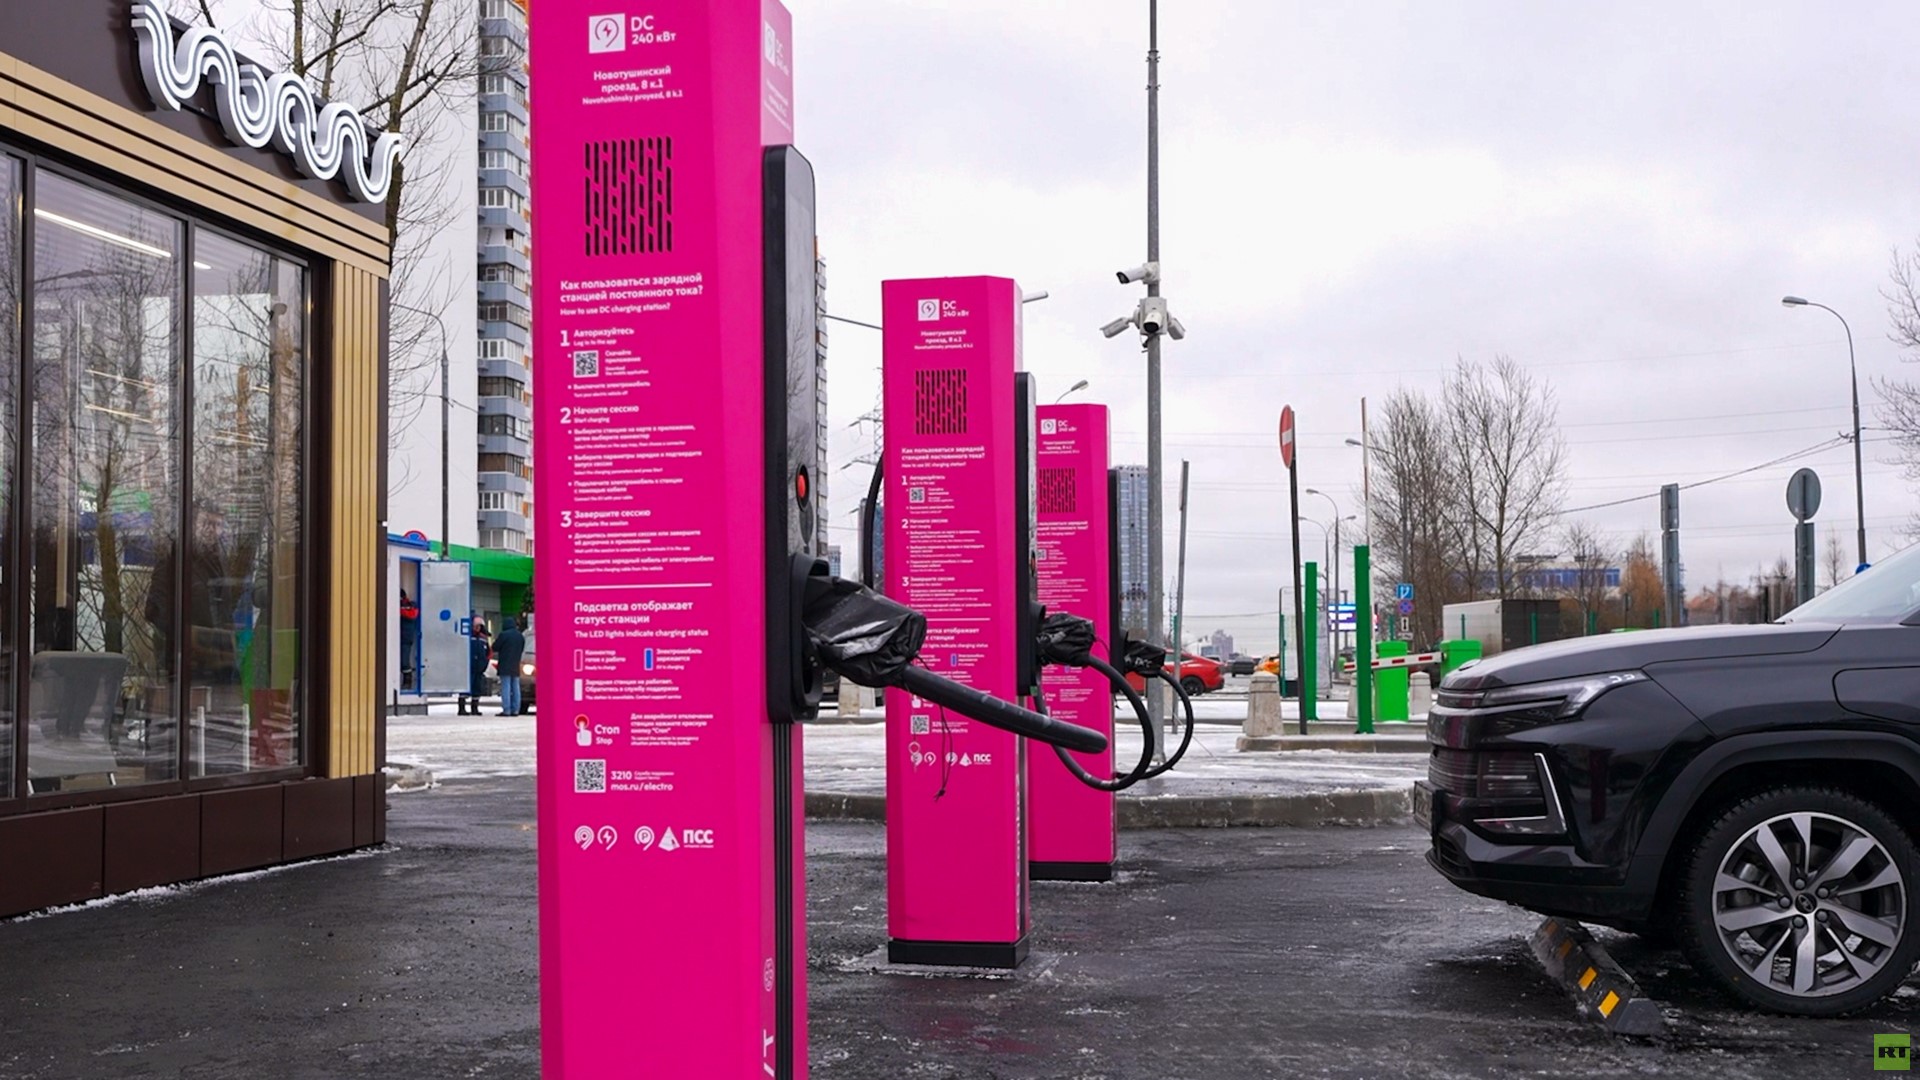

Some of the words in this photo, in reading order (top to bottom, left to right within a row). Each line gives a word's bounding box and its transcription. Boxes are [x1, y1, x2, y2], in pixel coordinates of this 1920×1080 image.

[631, 16, 654, 31] DC
[632, 33, 653, 44] 240
[656, 31, 676, 42] кВт
[594, 65, 671, 81] Новотушинский
[602, 82, 639, 94] проезд,
[642, 80, 648, 89] 8
[650, 79, 663, 89] к.1
[560, 281, 579, 290] Как
[582, 277, 650, 289] пользоваться
[652, 273, 702, 286] зарядной
[560, 291, 607, 303] станцией
[610, 288, 673, 300] постоянного
[676, 285, 703, 296] тока?
[600, 306, 610, 314] DC
[612, 304, 642, 314] charging
[644, 302, 671, 311] station?
[943, 300, 956, 310] DC
[560, 330, 570, 346] 1
[574, 328, 634, 338] Авторизуйтесь
[560, 408, 571, 424] 2
[902, 476, 908, 485] 1
[561, 511, 572, 527] 3
[574, 511, 619, 519] Завершите
[621, 509, 651, 517] сессию
[902, 518, 908, 528] 2
[902, 576, 909, 586] 3
[574, 602, 628, 613] Подсветка
[631, 601, 693, 612] отображает
[574, 616, 606, 626] статус
[608, 615, 650, 624] станции
[605, 630, 624, 639] lights
[655, 630, 686, 638] charging
[594, 724, 620, 734] Стоп
[596, 737, 613, 745] Stop
[974, 754, 991, 762] ПСС
[611, 770, 632, 780] 3210
[611, 782, 673, 791] mos.ru/electro
[683, 829, 714, 844] ПСС
